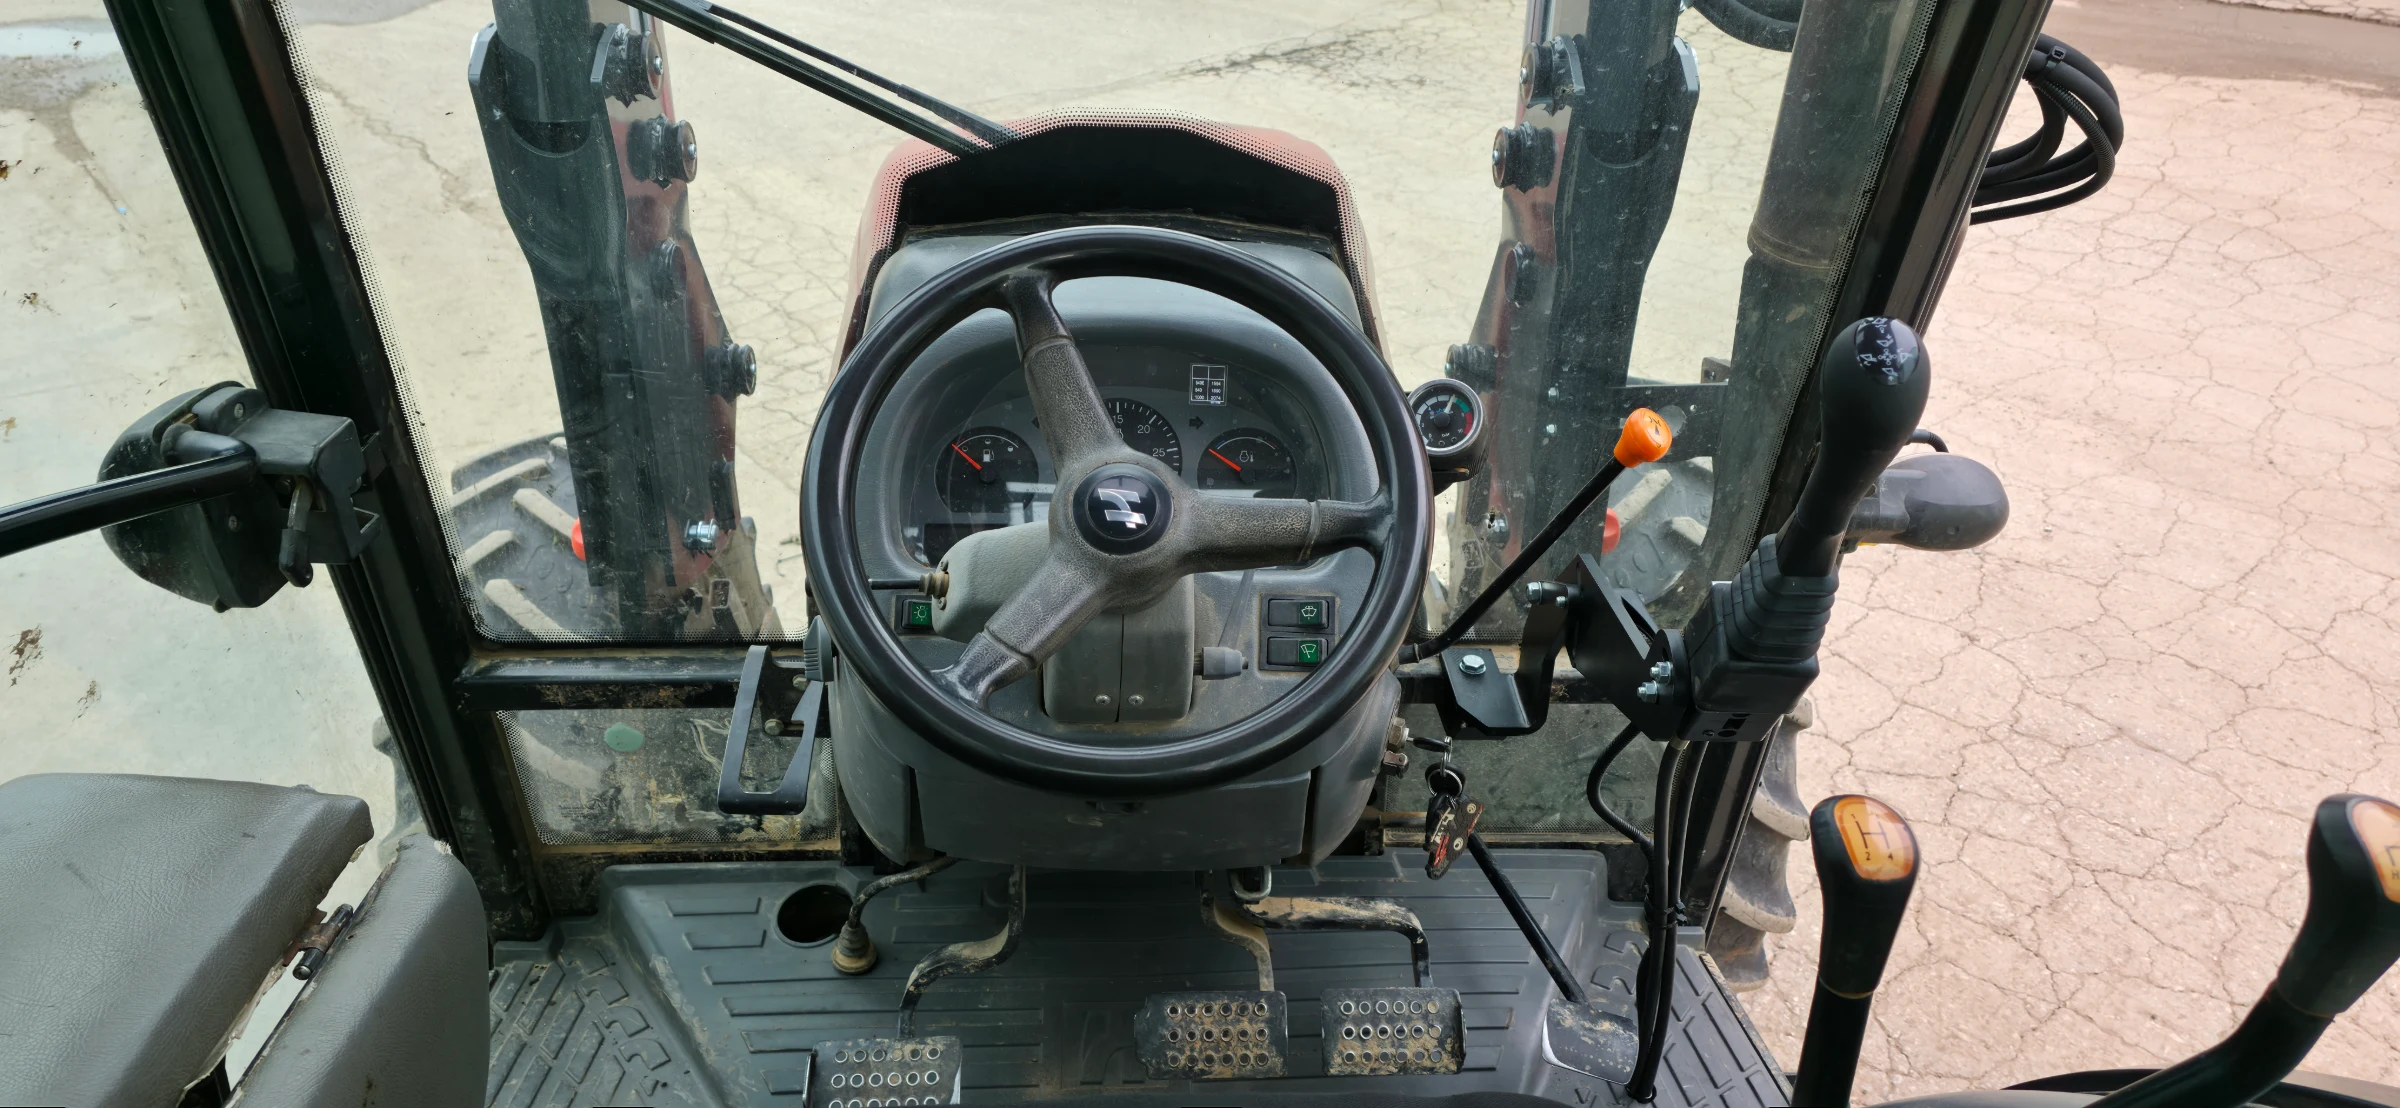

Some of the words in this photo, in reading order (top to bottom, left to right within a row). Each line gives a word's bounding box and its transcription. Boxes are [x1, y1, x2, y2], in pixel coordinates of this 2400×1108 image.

[1112, 414, 1124, 424] 15
[1137, 424, 1151, 434] 20
[1152, 447, 1166, 457] 25
[1865, 851, 1871, 861] 2
[1887, 853, 1894, 861] 4
